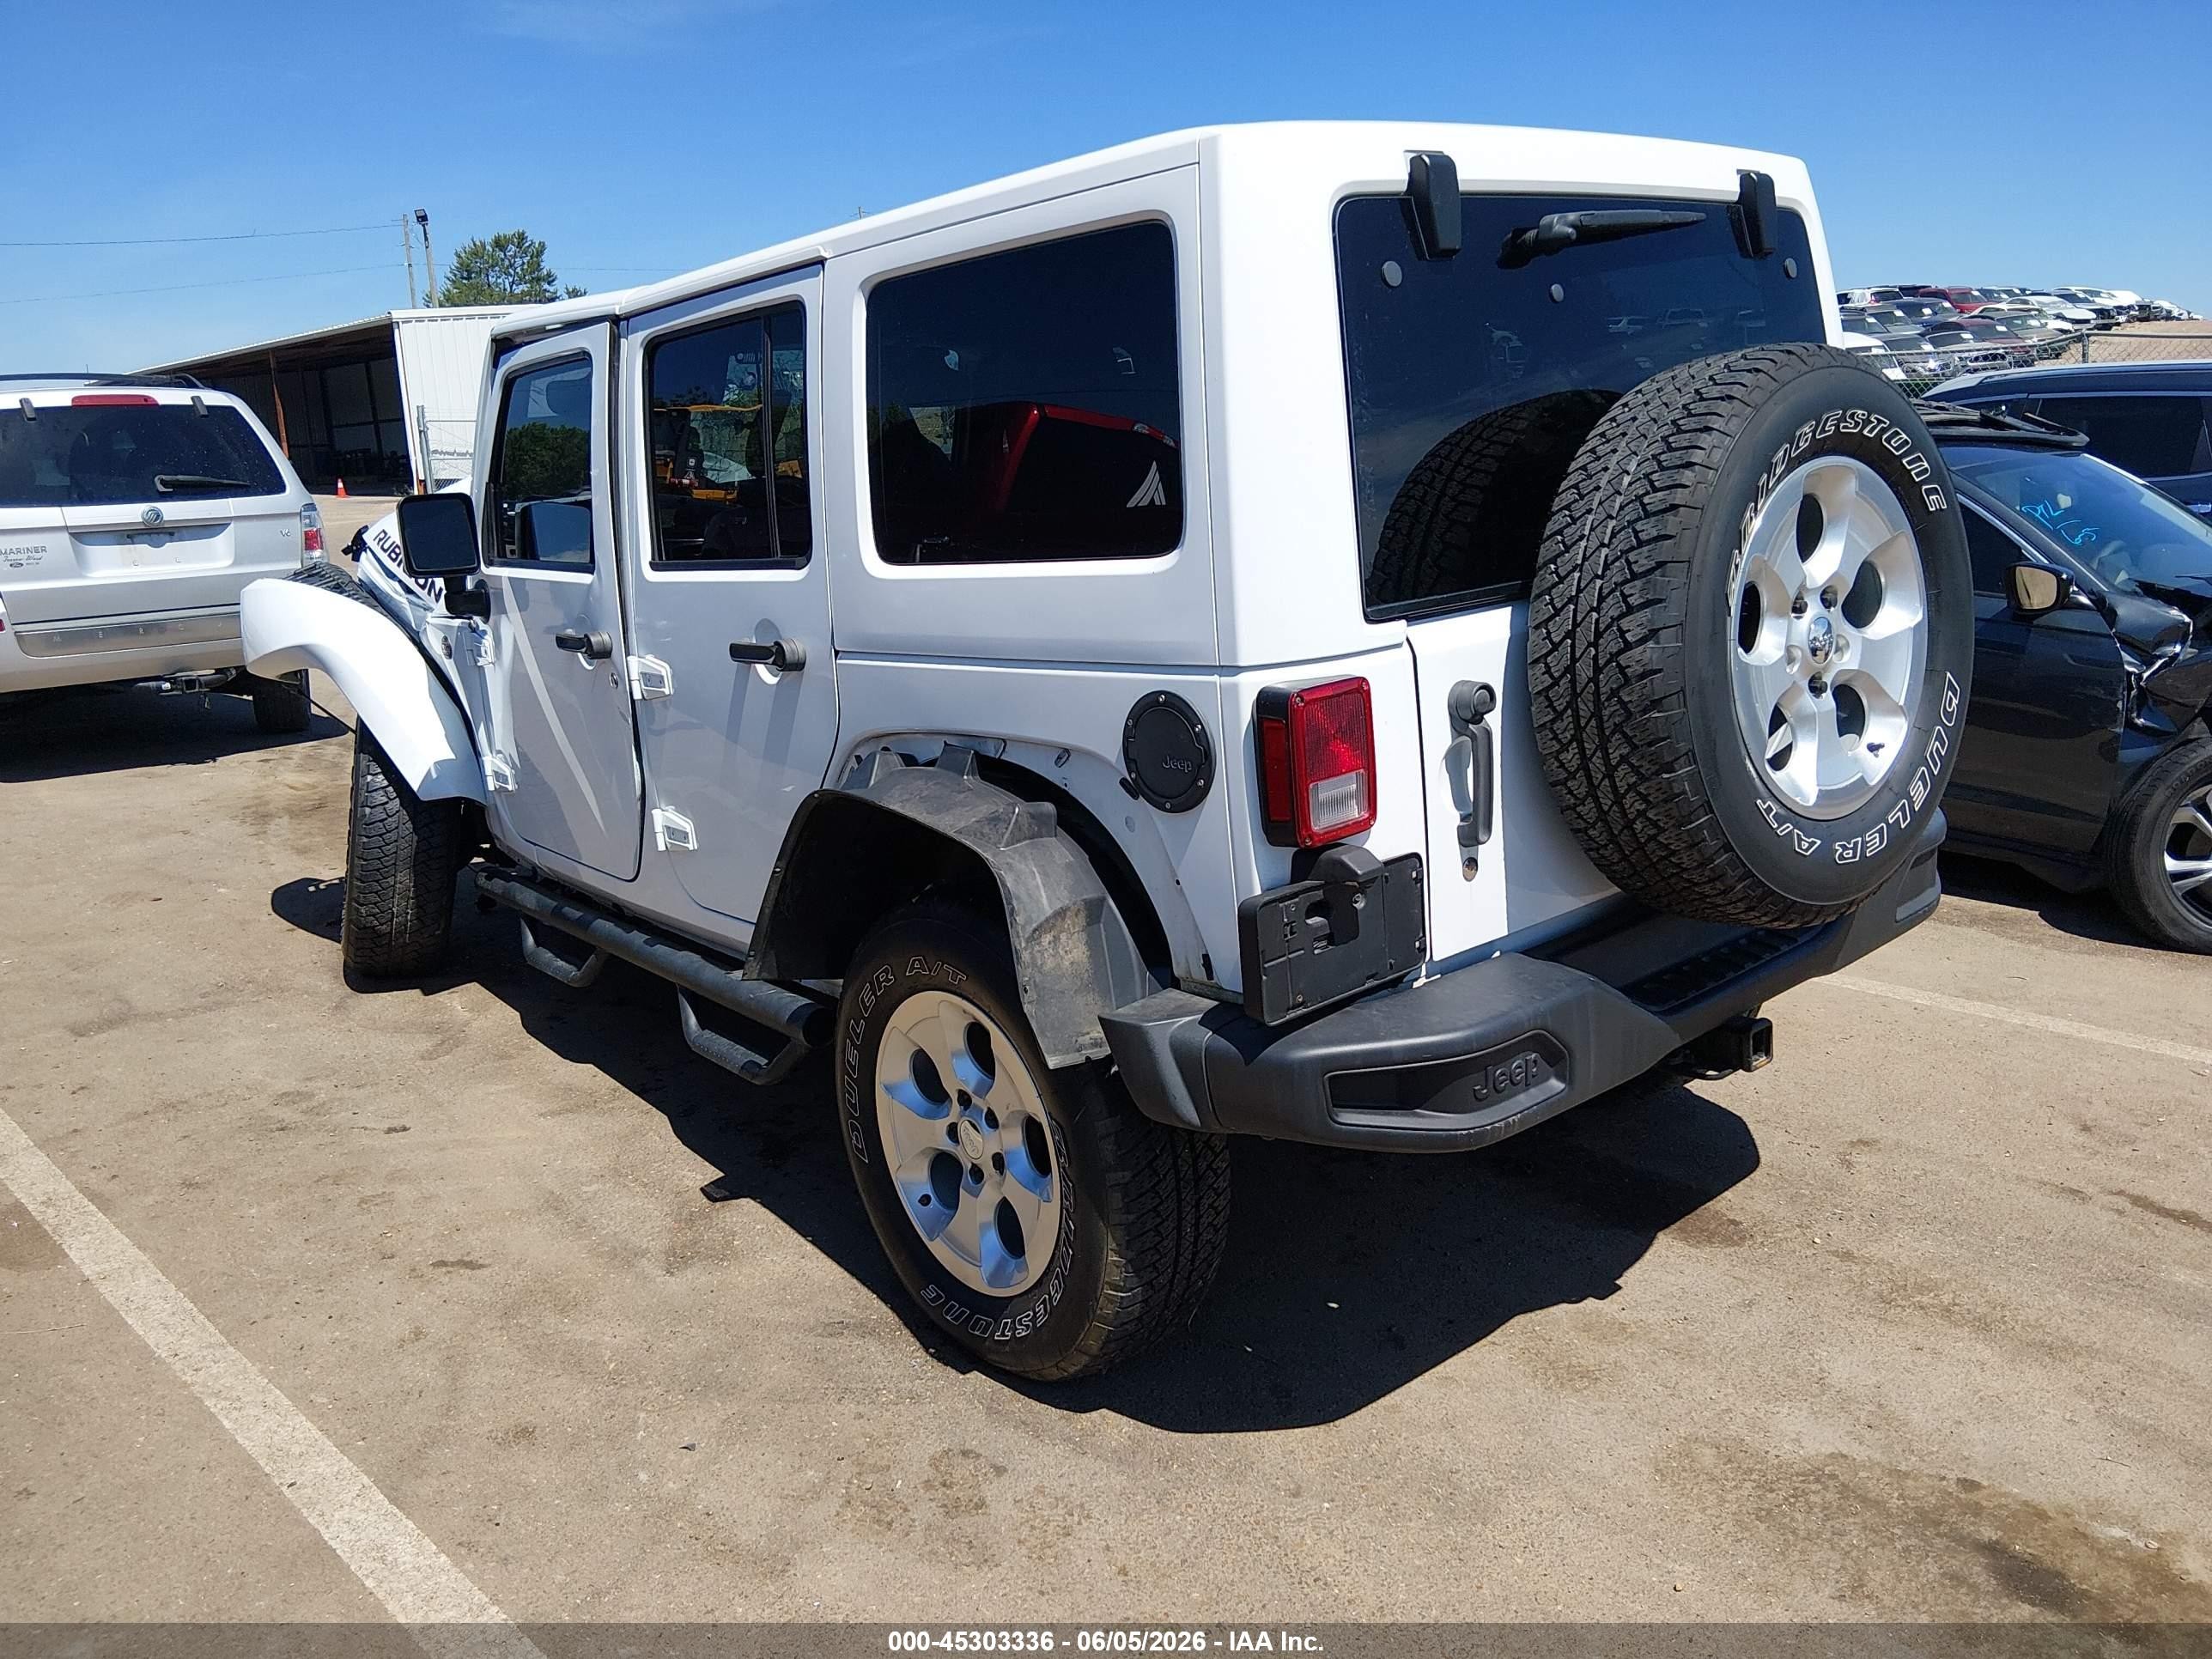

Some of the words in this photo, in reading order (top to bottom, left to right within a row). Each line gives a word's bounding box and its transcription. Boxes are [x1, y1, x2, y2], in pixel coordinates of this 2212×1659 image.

[0, 545, 48, 556] MARINER
[279, 528, 291, 538] V6
[373, 528, 444, 604] RUBON
[1162, 755, 1192, 773] Jeep
[1834, 671, 1960, 864] DUELER
[1756, 799, 1821, 855] A/T
[844, 964, 895, 1164] DUELER
[905, 956, 967, 985] A/T
[1473, 1053, 1540, 1102] Jeep
